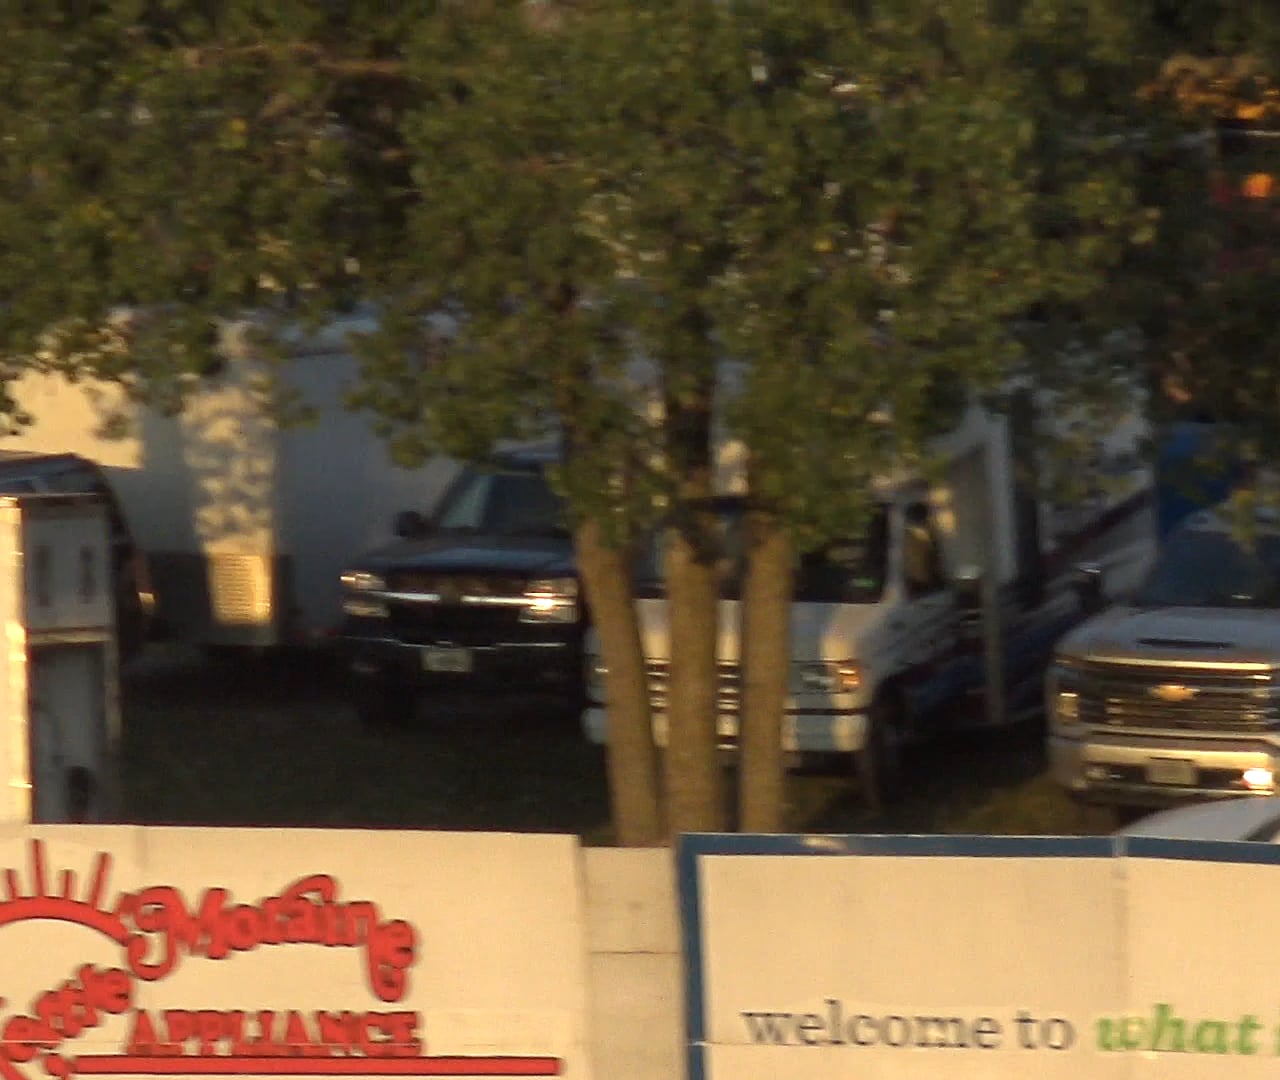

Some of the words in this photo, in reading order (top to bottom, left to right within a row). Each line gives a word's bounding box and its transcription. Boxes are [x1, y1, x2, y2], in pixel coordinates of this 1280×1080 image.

[120, 875, 416, 1002] Moraine
[124, 1008, 423, 1057] APPLIANCE
[740, 997, 1001, 1050] welcome
[1019, 1009, 1075, 1051] to
[1095, 1003, 1262, 1056] what
